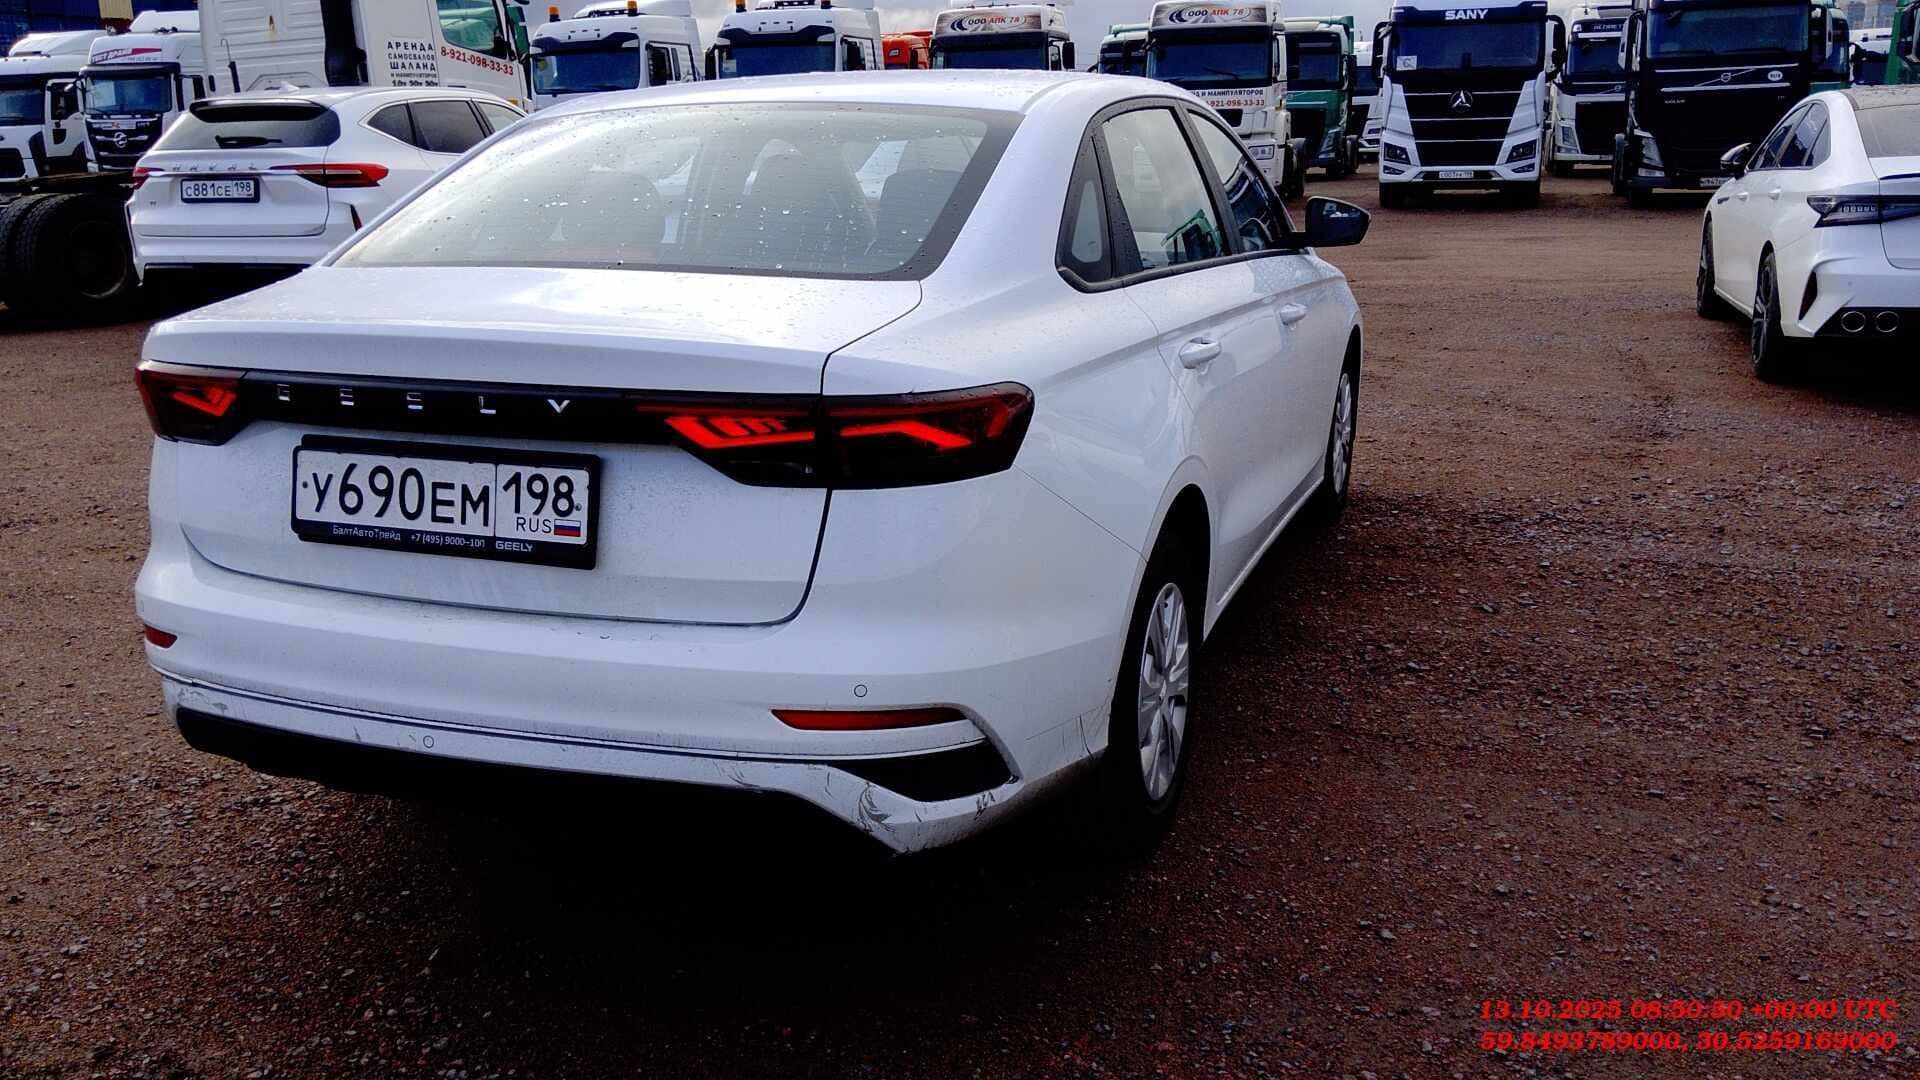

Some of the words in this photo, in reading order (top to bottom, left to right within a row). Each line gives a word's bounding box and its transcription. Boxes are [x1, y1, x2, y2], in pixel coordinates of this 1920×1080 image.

[1210, 8, 1229, 16] АПК
[1445, 9, 1489, 20] SANY
[387, 41, 434, 51] АРЕНДА
[389, 61, 436, 72] ШАЛАНД
[440, 46, 514, 76] 8-921-098-33-33
[1207, 89, 1264, 97] МАНИПУЛЯТОРОВ
[1206, 99, 1265, 107] -921-098-33-33
[185, 183, 232, 197] С881СЕ
[234, 182, 251, 193] 198
[312, 463, 490, 527] У690ЕМ
[502, 471, 575, 518] 198
[515, 516, 552, 534] RUS
[332, 525, 402, 541] БалтАвтоТрейд
[410, 534, 422, 544] +7
[422, 534, 444, 547] (495)
[495, 541, 534, 552] GEELY
